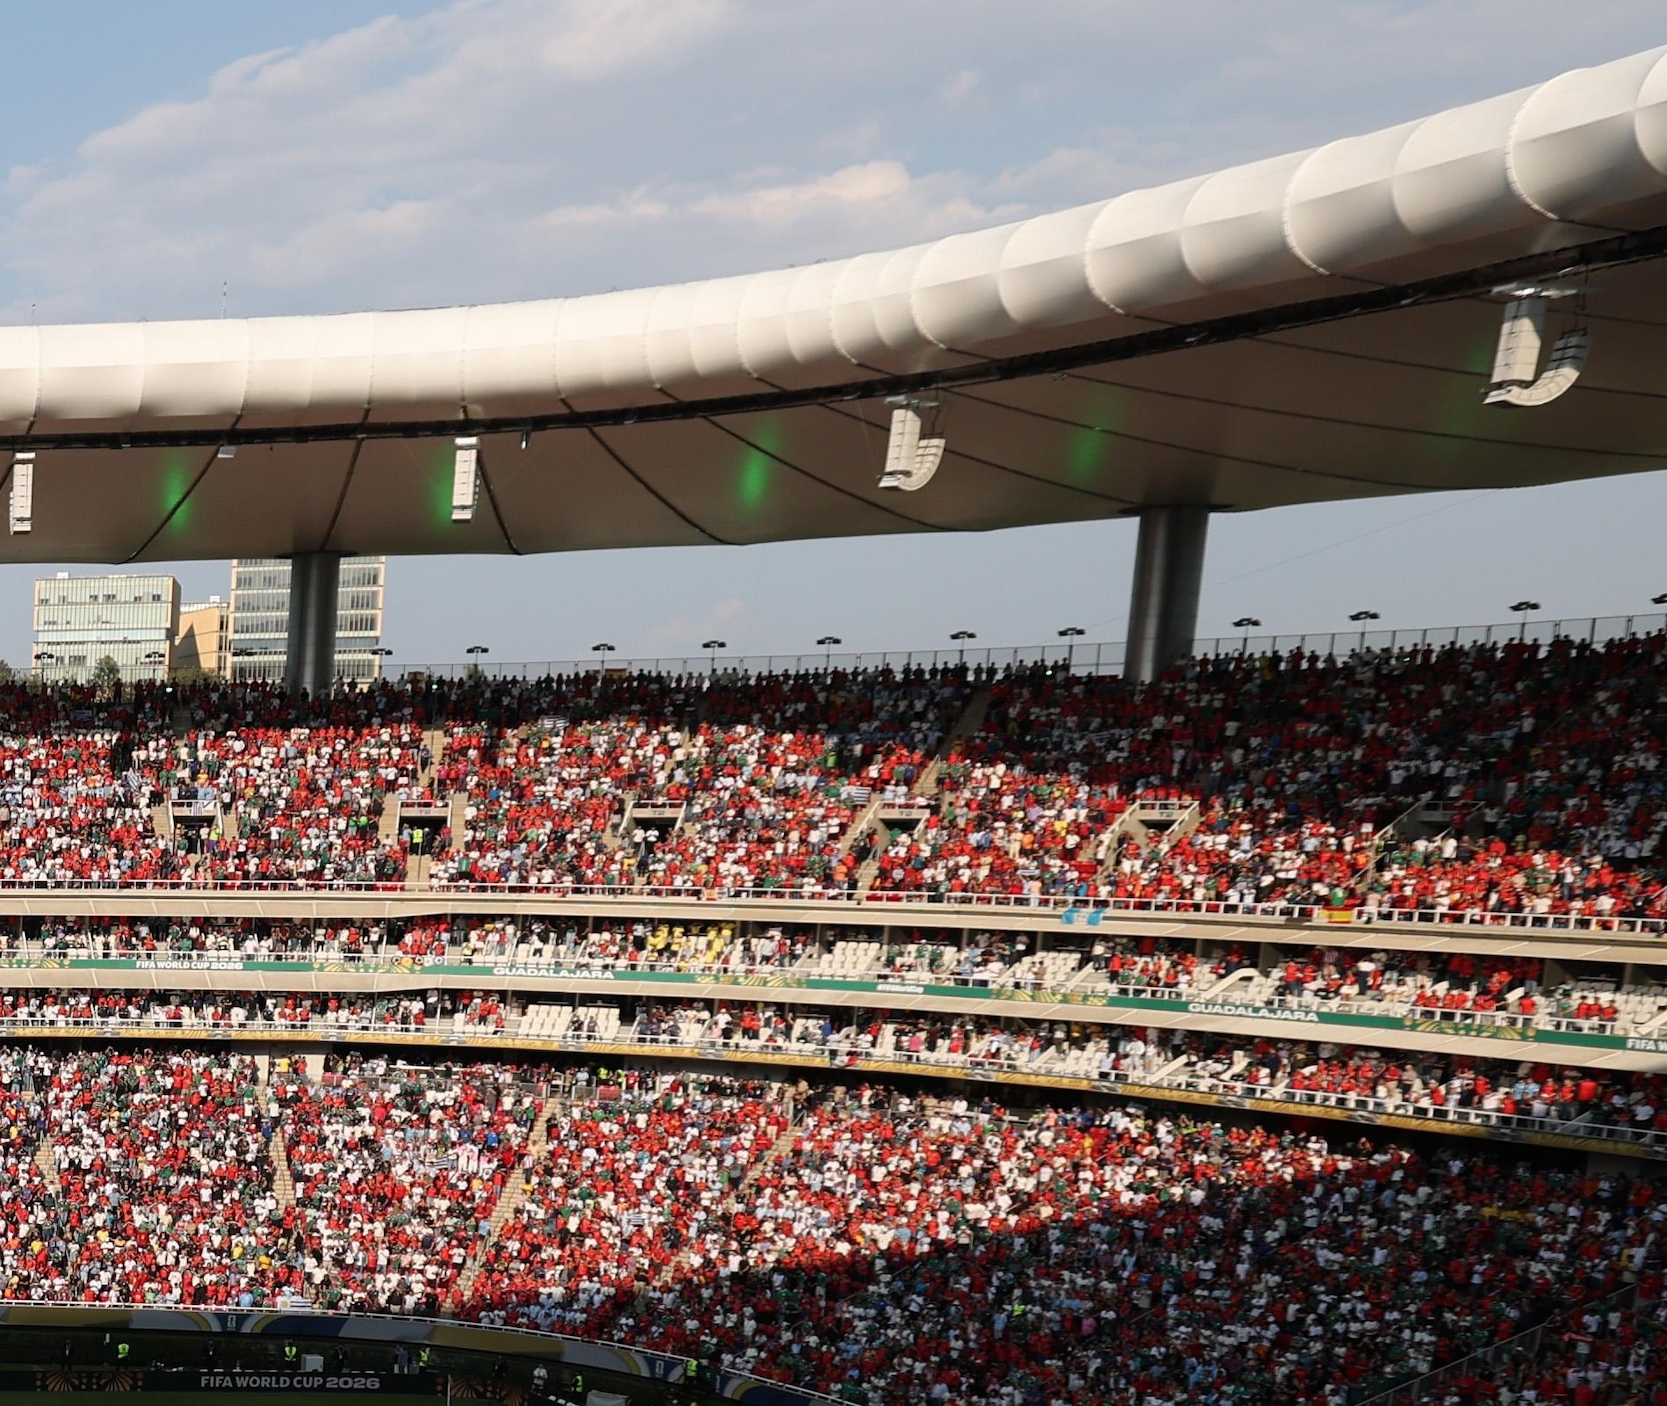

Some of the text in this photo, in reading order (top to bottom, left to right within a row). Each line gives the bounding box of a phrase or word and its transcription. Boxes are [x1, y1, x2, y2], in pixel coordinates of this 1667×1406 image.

[136, 960, 244, 969] FIFA WORLD CUP 2026
[493, 967, 615, 979] GUADALAJARA
[1188, 1003, 1319, 1021] GUADALAJARA
[1627, 1038, 1656, 1050] FIFA
[200, 1376, 381, 1389] FIFA WORLD CUP 2026
